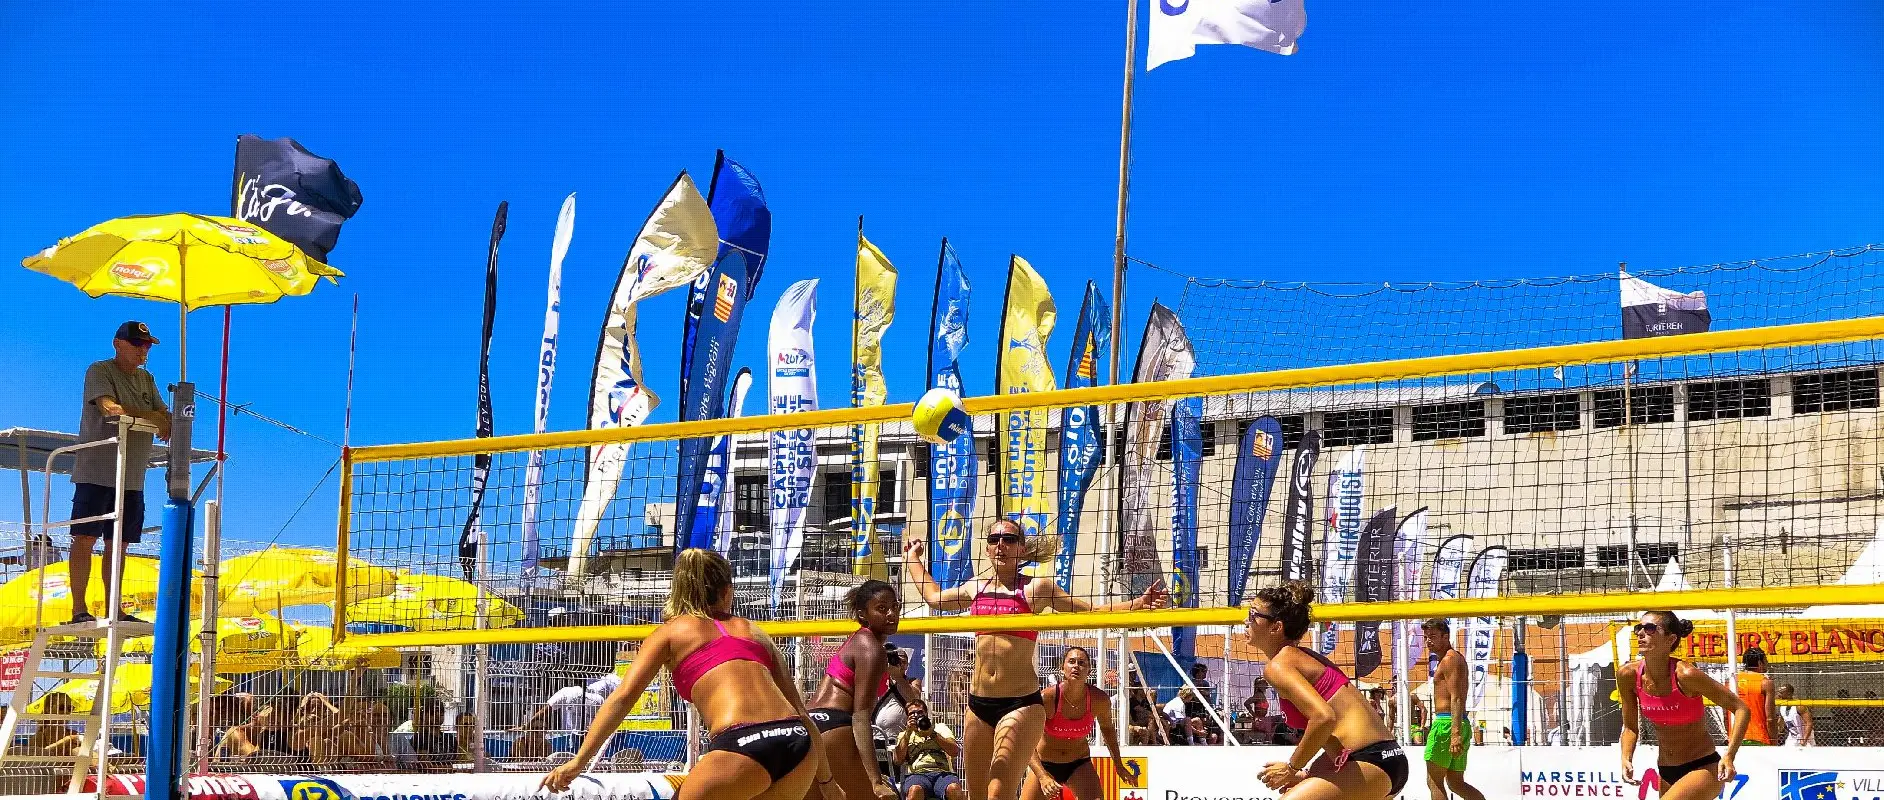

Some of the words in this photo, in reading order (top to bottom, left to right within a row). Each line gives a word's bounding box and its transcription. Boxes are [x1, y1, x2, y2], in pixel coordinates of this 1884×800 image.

[776, 394, 788, 508] CAPITAE
[787, 394, 797, 508] EUROPÉENE
[796, 394, 813, 470] SPOT
[1368, 527, 1382, 601] URTERER
[1686, 631, 1782, 657] HENRY
[737, 732, 761, 747] Sun
[761, 727, 793, 738] Valley
[1521, 771, 1620, 783] MARSEILL
[1521, 785, 1624, 797] PROVENCE
